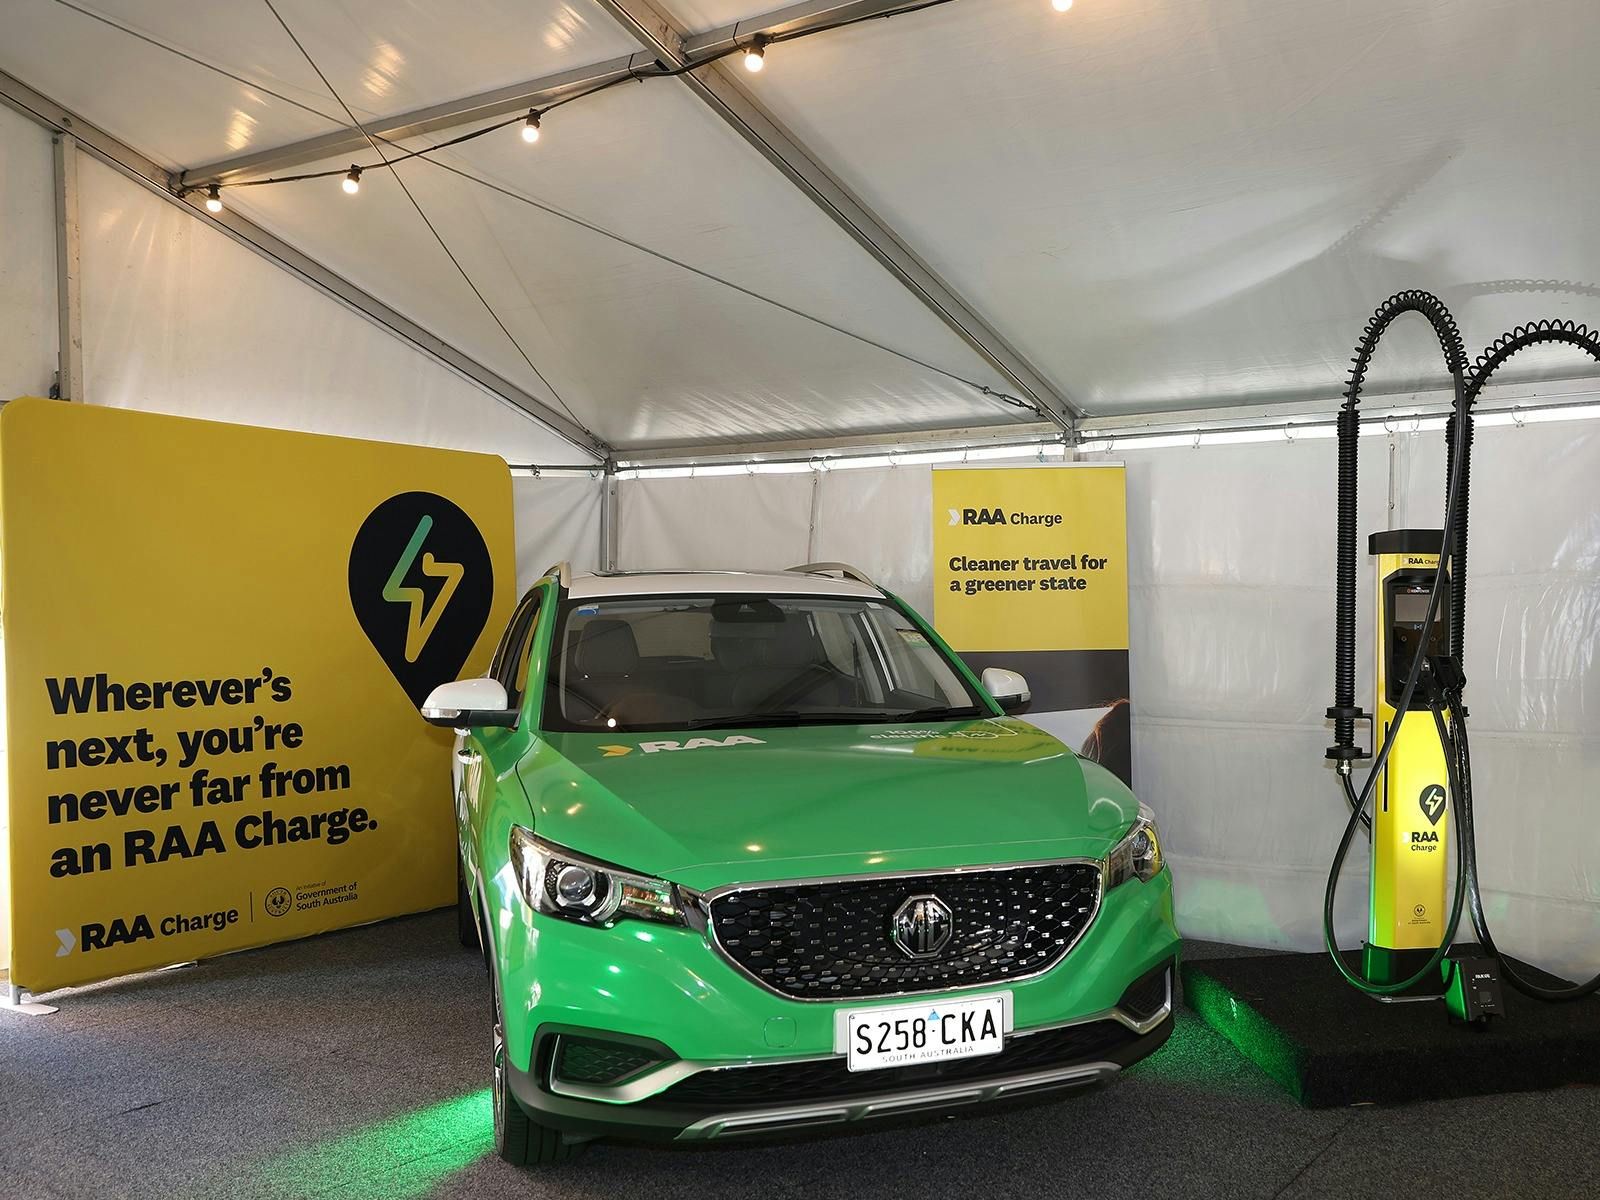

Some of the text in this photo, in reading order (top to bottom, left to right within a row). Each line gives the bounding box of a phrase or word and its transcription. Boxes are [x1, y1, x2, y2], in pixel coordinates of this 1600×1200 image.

[963, 509, 1063, 527] RAA Charge
[949, 555, 1107, 571] Cleaner travel for
[950, 576, 1087, 595] a greener state
[46, 728, 168, 769] next,
[639, 735, 767, 753] RAA
[48, 762, 350, 824] never far from
[49, 806, 378, 877] an RAA Charge.
[1412, 831, 1439, 842] RAA
[1411, 844, 1437, 852] Charge
[296, 882, 358, 901] Government of
[296, 899, 321, 911] South
[323, 892, 358, 906] Australia
[81, 907, 239, 952] RAA Charge
[900, 900, 949, 952] MG
[882, 1046, 974, 1063] SOUTH AUSTRALIA
